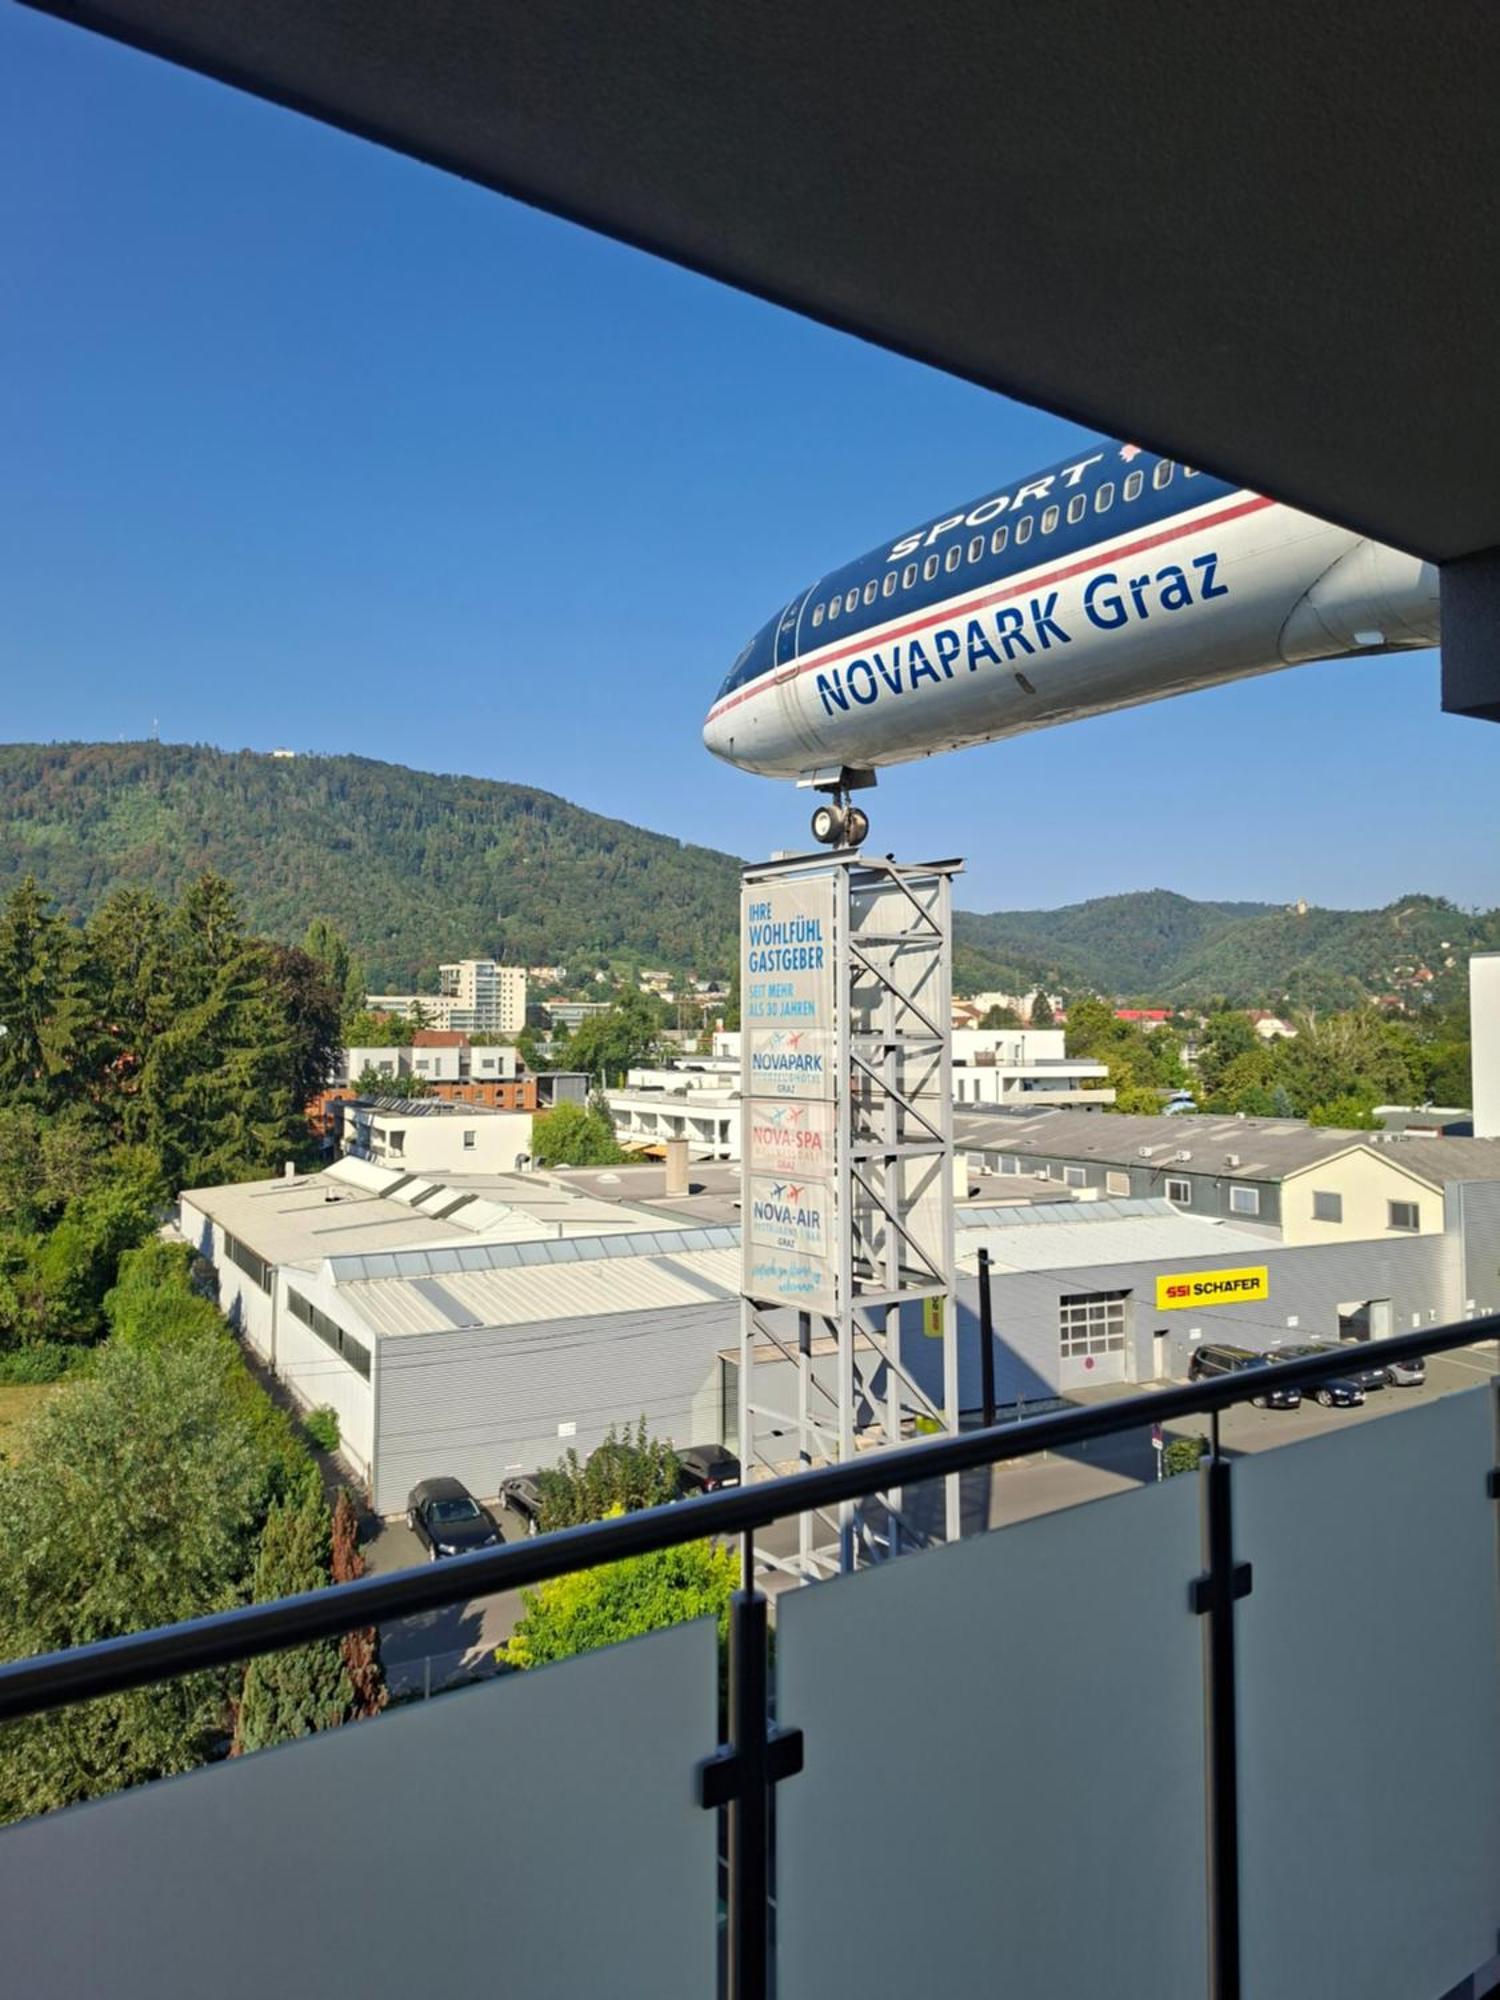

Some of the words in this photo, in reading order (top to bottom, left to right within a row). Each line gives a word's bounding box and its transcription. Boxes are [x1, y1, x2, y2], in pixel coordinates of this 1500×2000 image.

[886, 453, 1104, 562] SPORT
[816, 592, 1071, 716] NOVAPARK
[1083, 552, 1229, 630] Graz
[749, 902, 771, 920] IHRE
[749, 915, 823, 946] WOHLFÜHL
[749, 947, 824, 973] GASTGEBER
[767, 983, 793, 998] MEHR
[752, 1052, 822, 1072] NOVAPARK
[753, 1201, 821, 1229] NOVA-AIR
[1166, 1285, 1190, 1298] SSI
